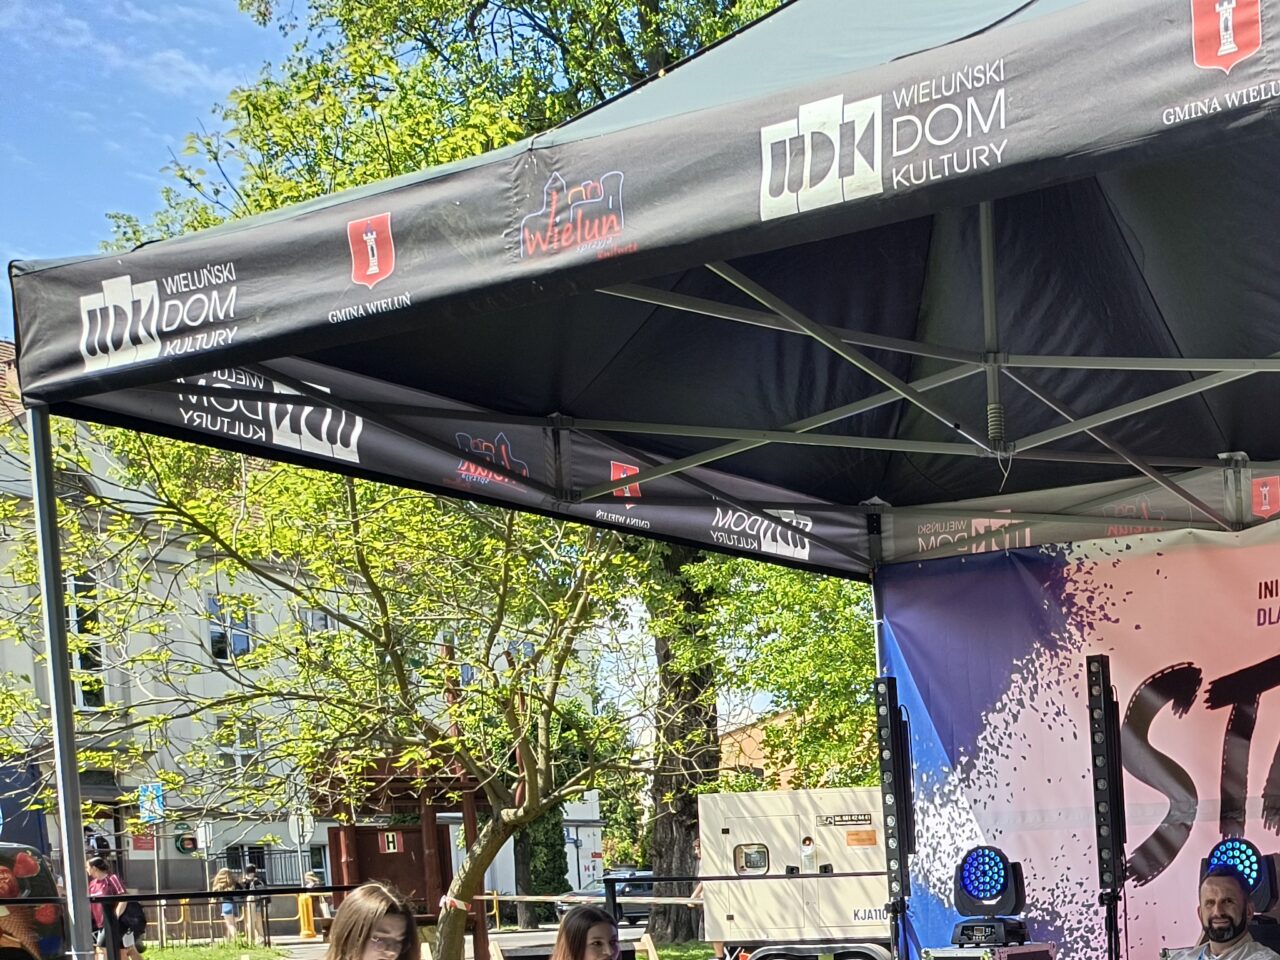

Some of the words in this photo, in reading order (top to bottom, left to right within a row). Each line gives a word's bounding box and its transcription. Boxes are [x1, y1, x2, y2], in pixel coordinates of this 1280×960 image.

[893, 58, 1005, 110] WIELUŃSKI
[892, 88, 1006, 158] DOM
[1162, 97, 1222, 125] GMINA
[892, 139, 1008, 190] KULTURY
[162, 262, 237, 295] WIELUŃSKI
[162, 286, 237, 332] DOM
[328, 304, 366, 324] GMINA
[366, 291, 412, 315] WIELUŃ
[163, 326, 239, 357] KULTURY
[386, 834, 396, 850] H
